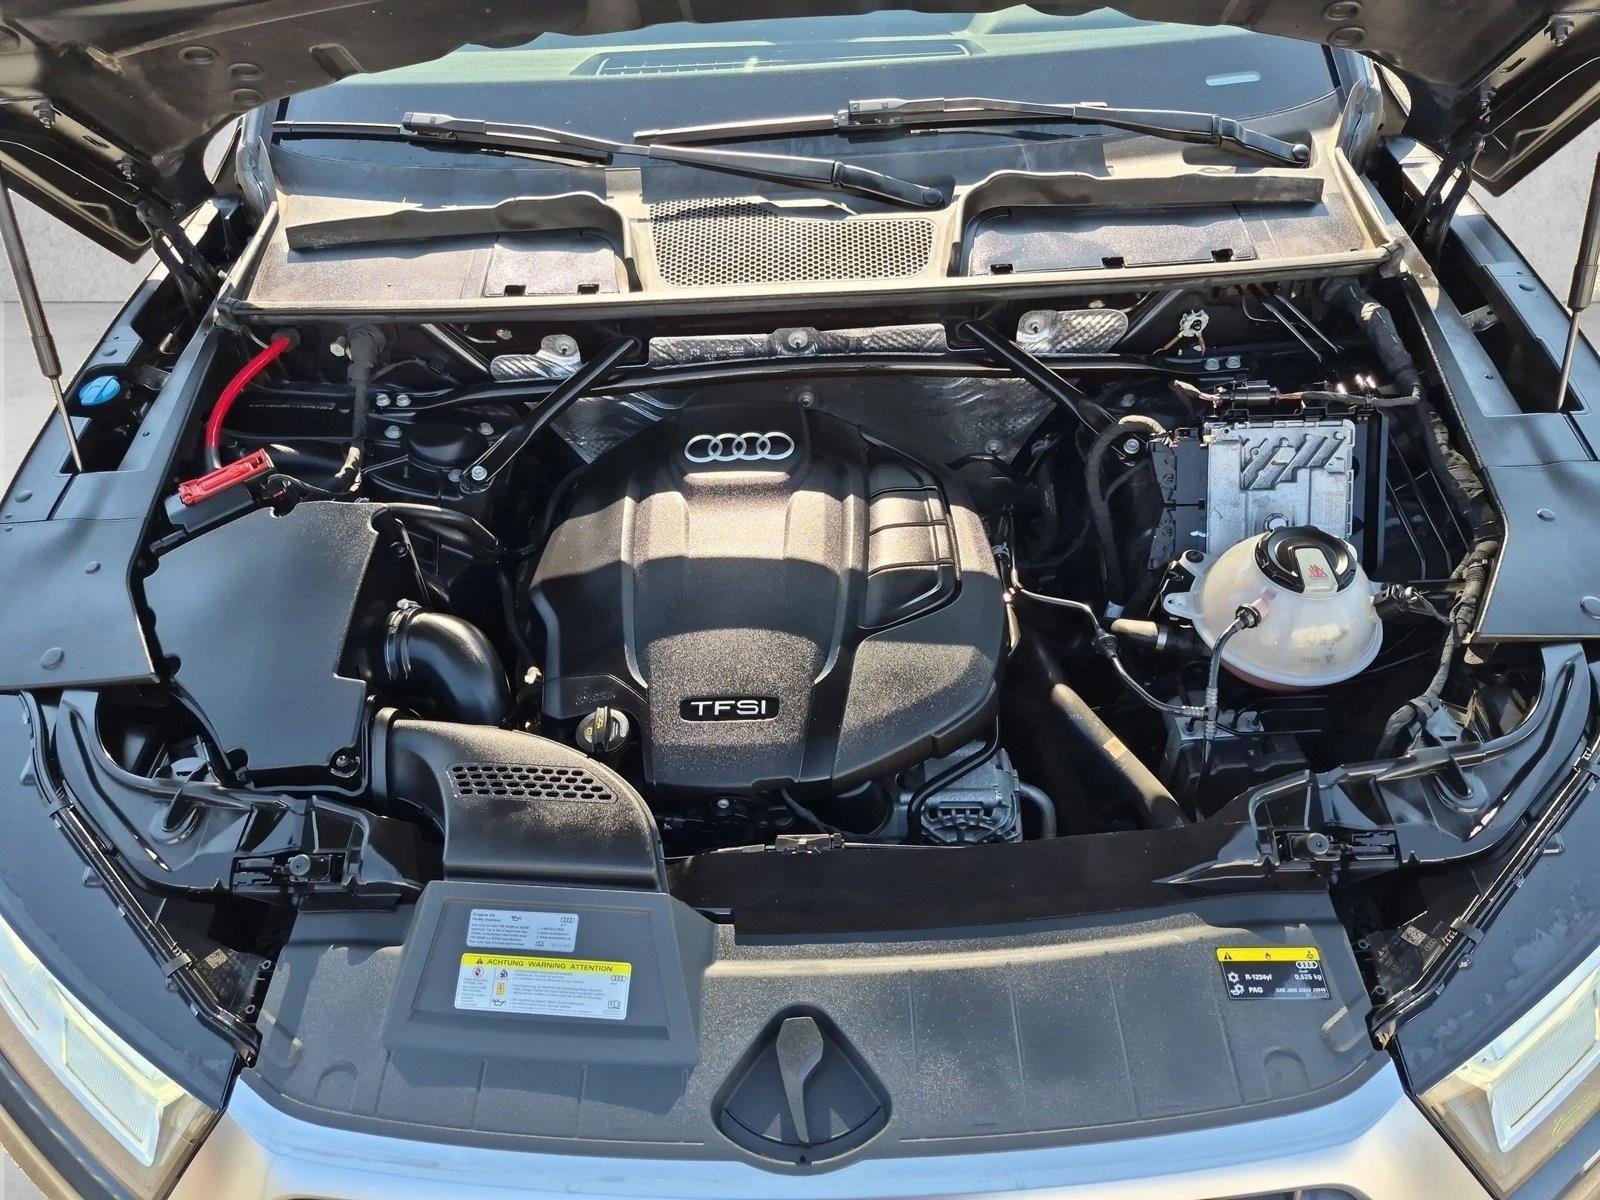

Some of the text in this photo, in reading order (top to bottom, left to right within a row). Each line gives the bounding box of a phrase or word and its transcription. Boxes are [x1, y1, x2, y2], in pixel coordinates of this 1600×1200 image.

[690, 699, 766, 716] TFSI
[487, 958, 613, 973] ACHTUNG WARNING ATTENTION
[1245, 973, 1272, 982] R-1234yf
[1248, 986, 1264, 994] PAG
